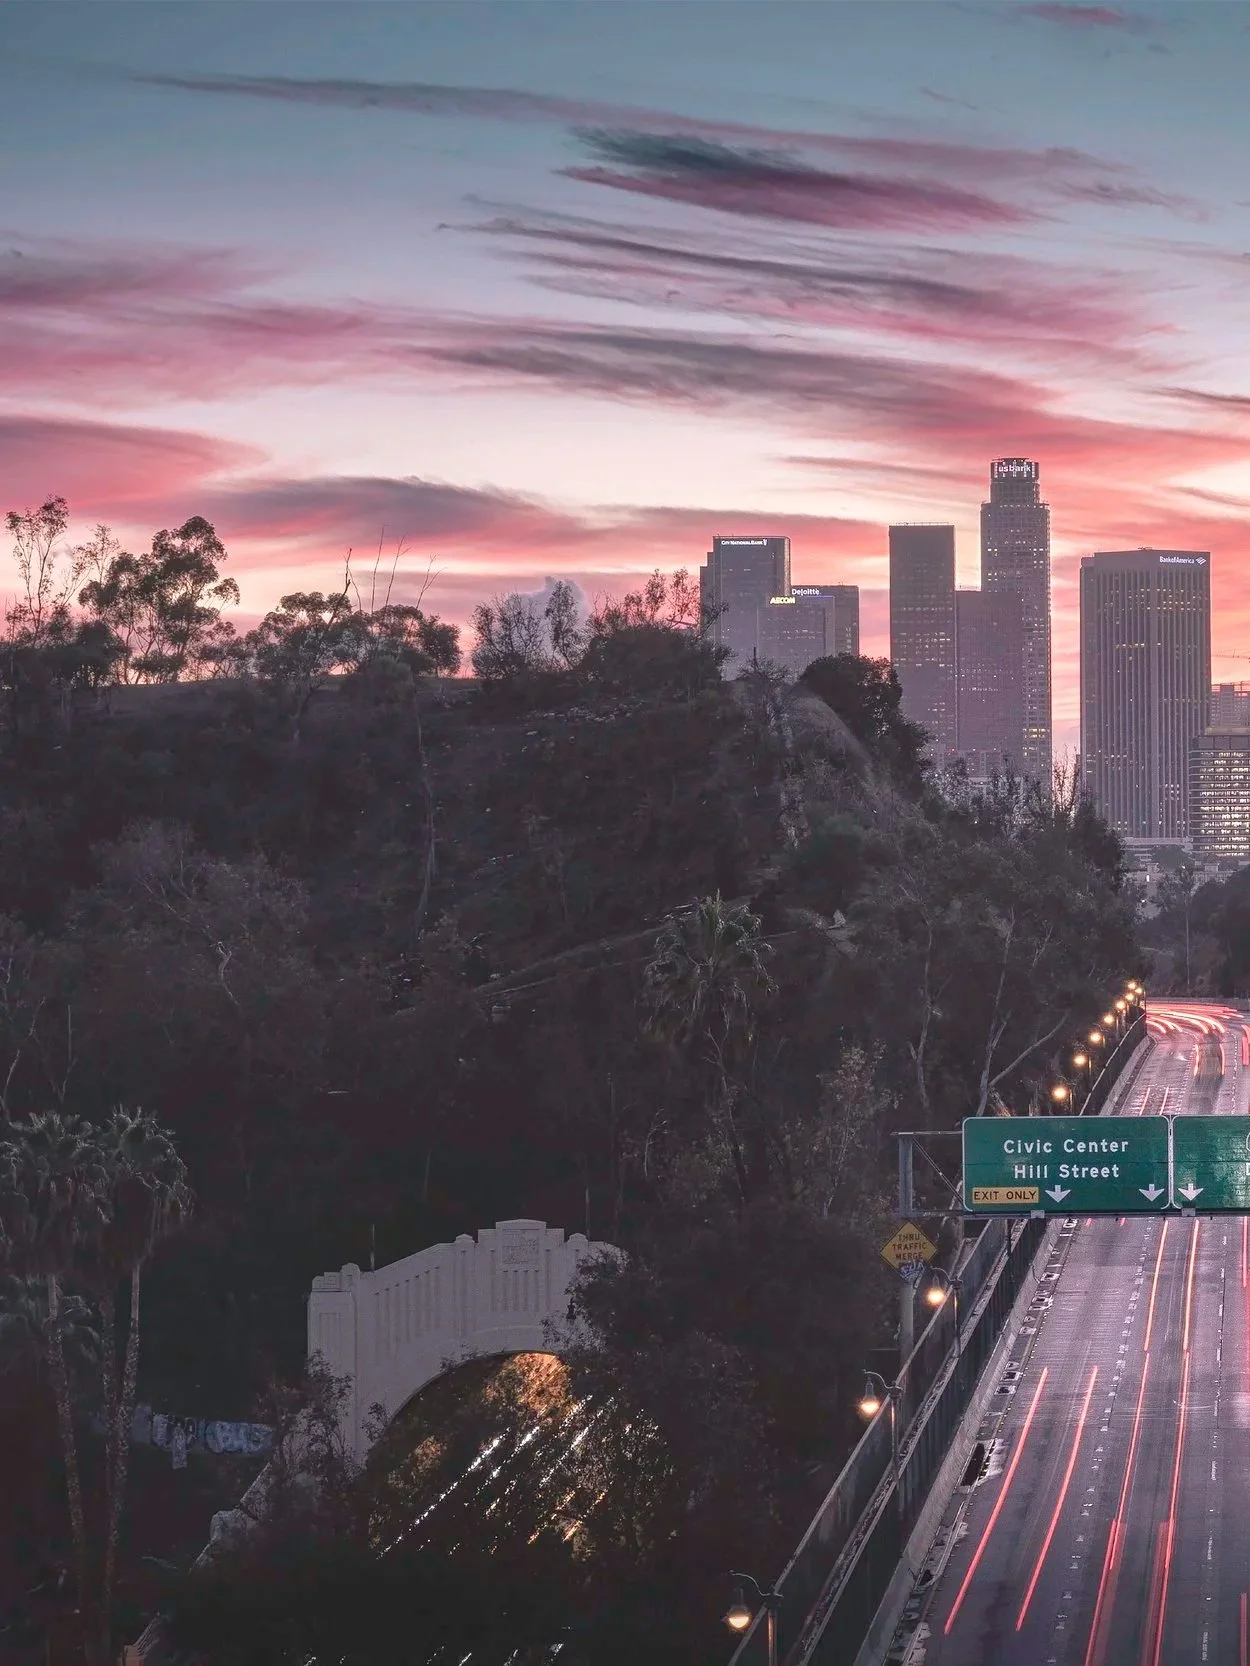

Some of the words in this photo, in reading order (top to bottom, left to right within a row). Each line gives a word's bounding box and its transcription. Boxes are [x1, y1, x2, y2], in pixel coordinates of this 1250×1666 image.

[1003, 1139, 1053, 1154] Civic
[1063, 1139, 1129, 1153] Center
[1014, 1164, 1048, 1179] Hill
[1059, 1164, 1120, 1178] Street
[973, 1191, 999, 1200] EXIT
[1006, 1190, 1037, 1200] ONLY
[898, 1233, 920, 1241] THRU
[892, 1242, 928, 1250] TRAFFIC
[895, 1252, 924, 1260] MERGE
